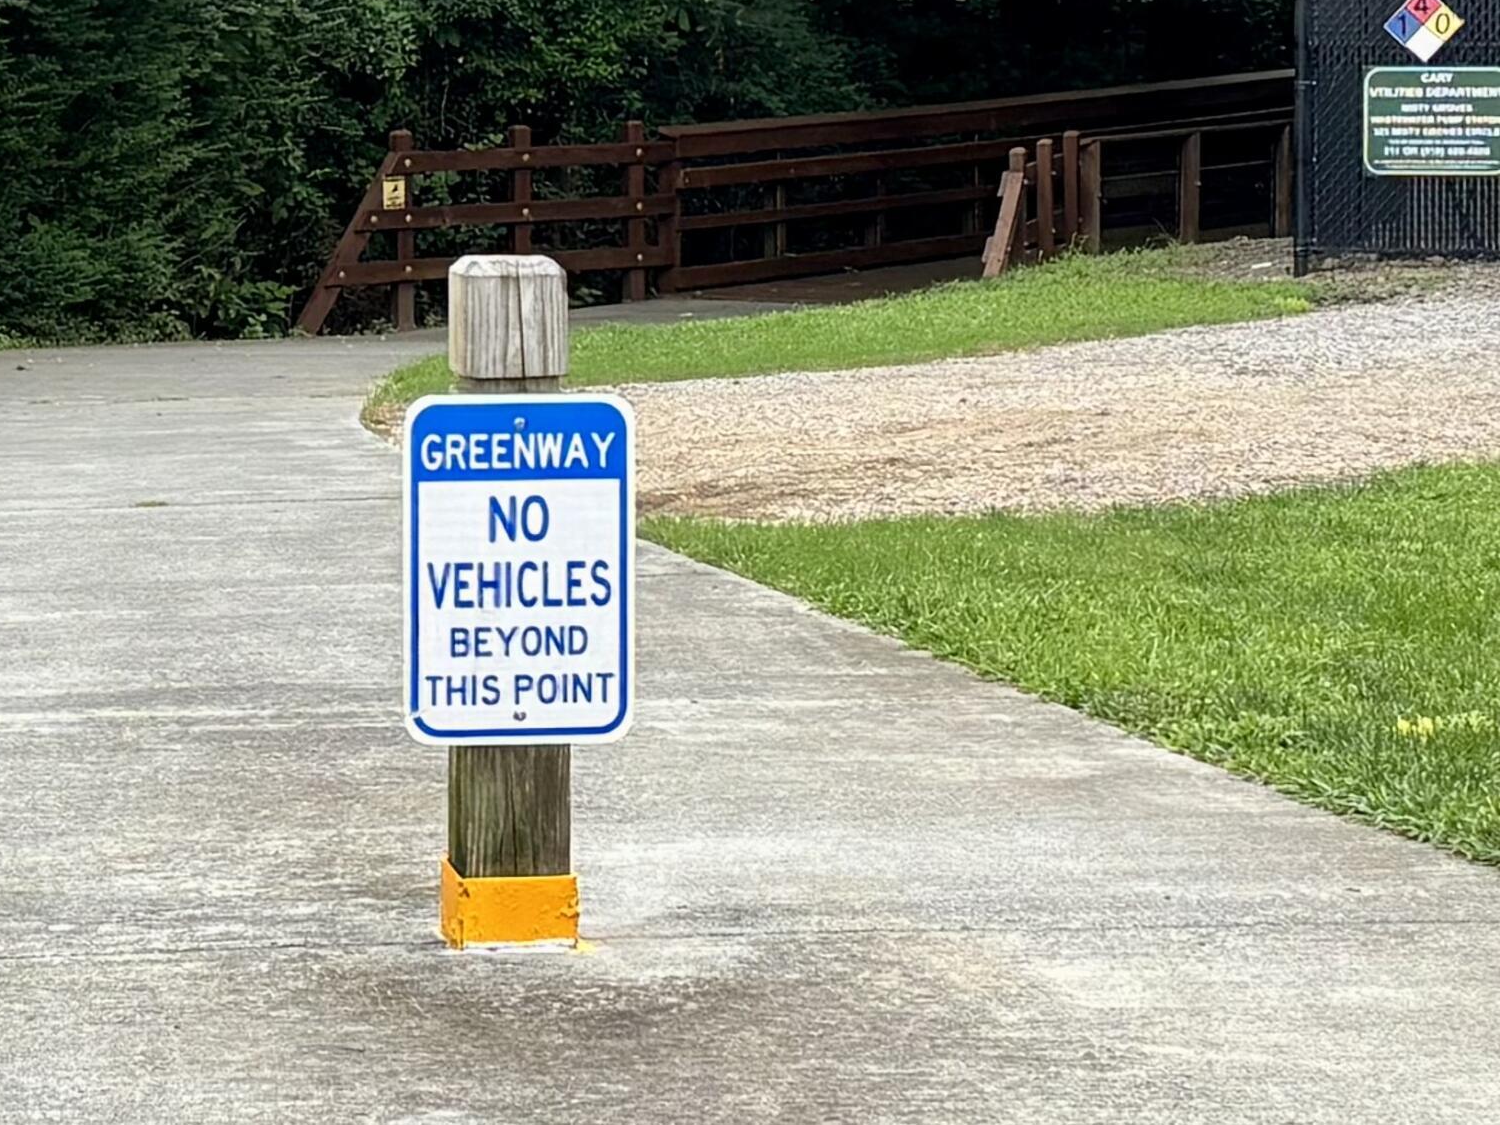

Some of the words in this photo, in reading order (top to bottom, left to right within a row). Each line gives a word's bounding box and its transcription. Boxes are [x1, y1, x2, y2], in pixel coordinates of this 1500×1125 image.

[1398, 14, 1406, 37] 1
[1435, 13, 1450, 35] 0
[1369, 87, 1423, 98] UTILITIES
[1420, 73, 1453, 83] CARY
[420, 432, 616, 471] GREENWAY
[488, 495, 549, 543] NO
[427, 559, 612, 610] VEHICLES
[449, 625, 589, 658] BEYOND
[425, 675, 501, 706] THIS
[513, 673, 615, 705] POINT
